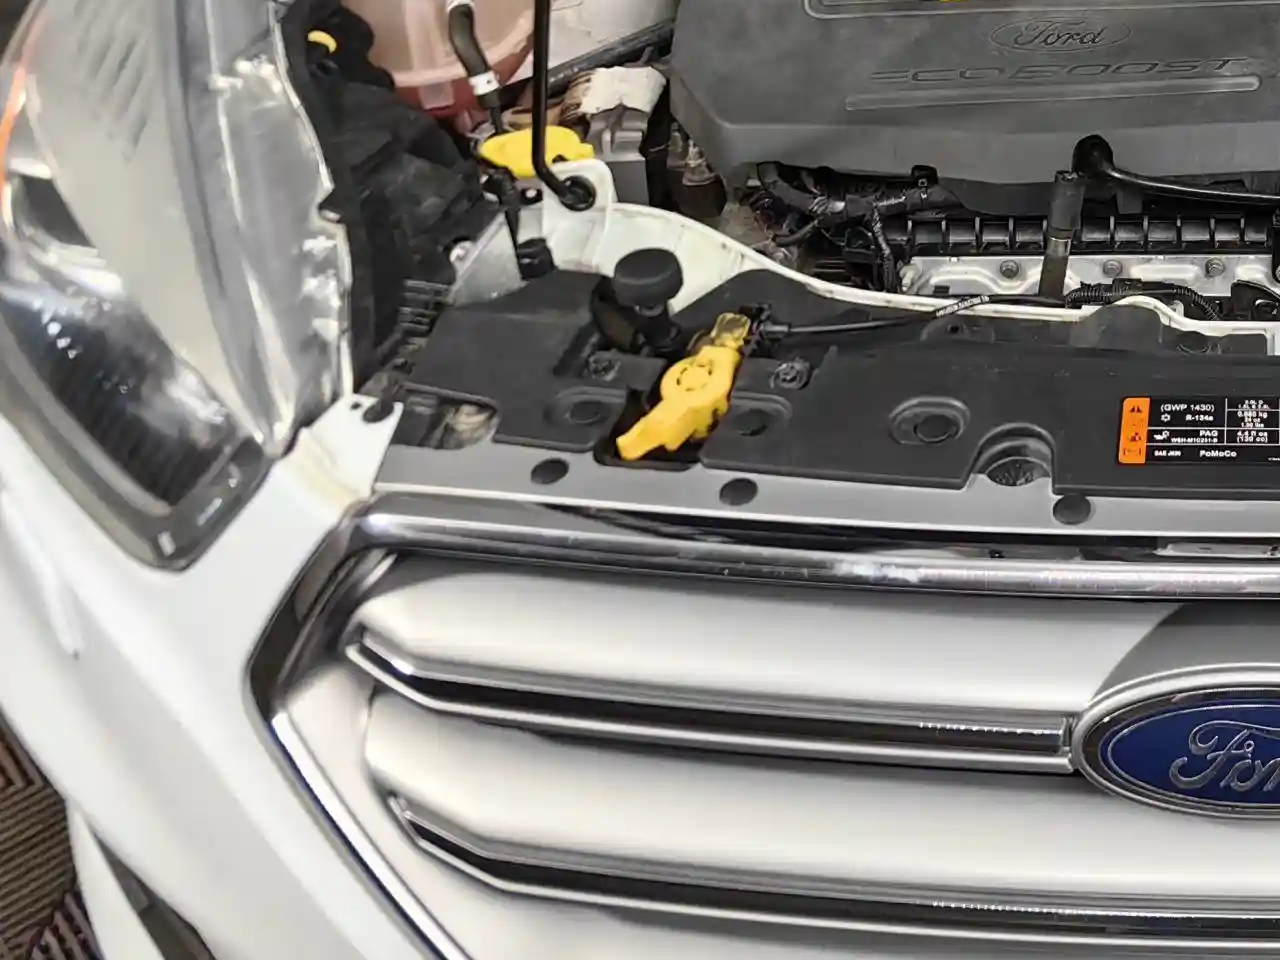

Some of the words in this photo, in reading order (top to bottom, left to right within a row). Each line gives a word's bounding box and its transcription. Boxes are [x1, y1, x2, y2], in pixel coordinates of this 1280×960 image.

[1013, 18, 1107, 47] Ford
[870, 56, 1252, 83] ECOBOOST
[1160, 404, 1187, 413] (GWP
[1190, 404, 1215, 413] 1430)
